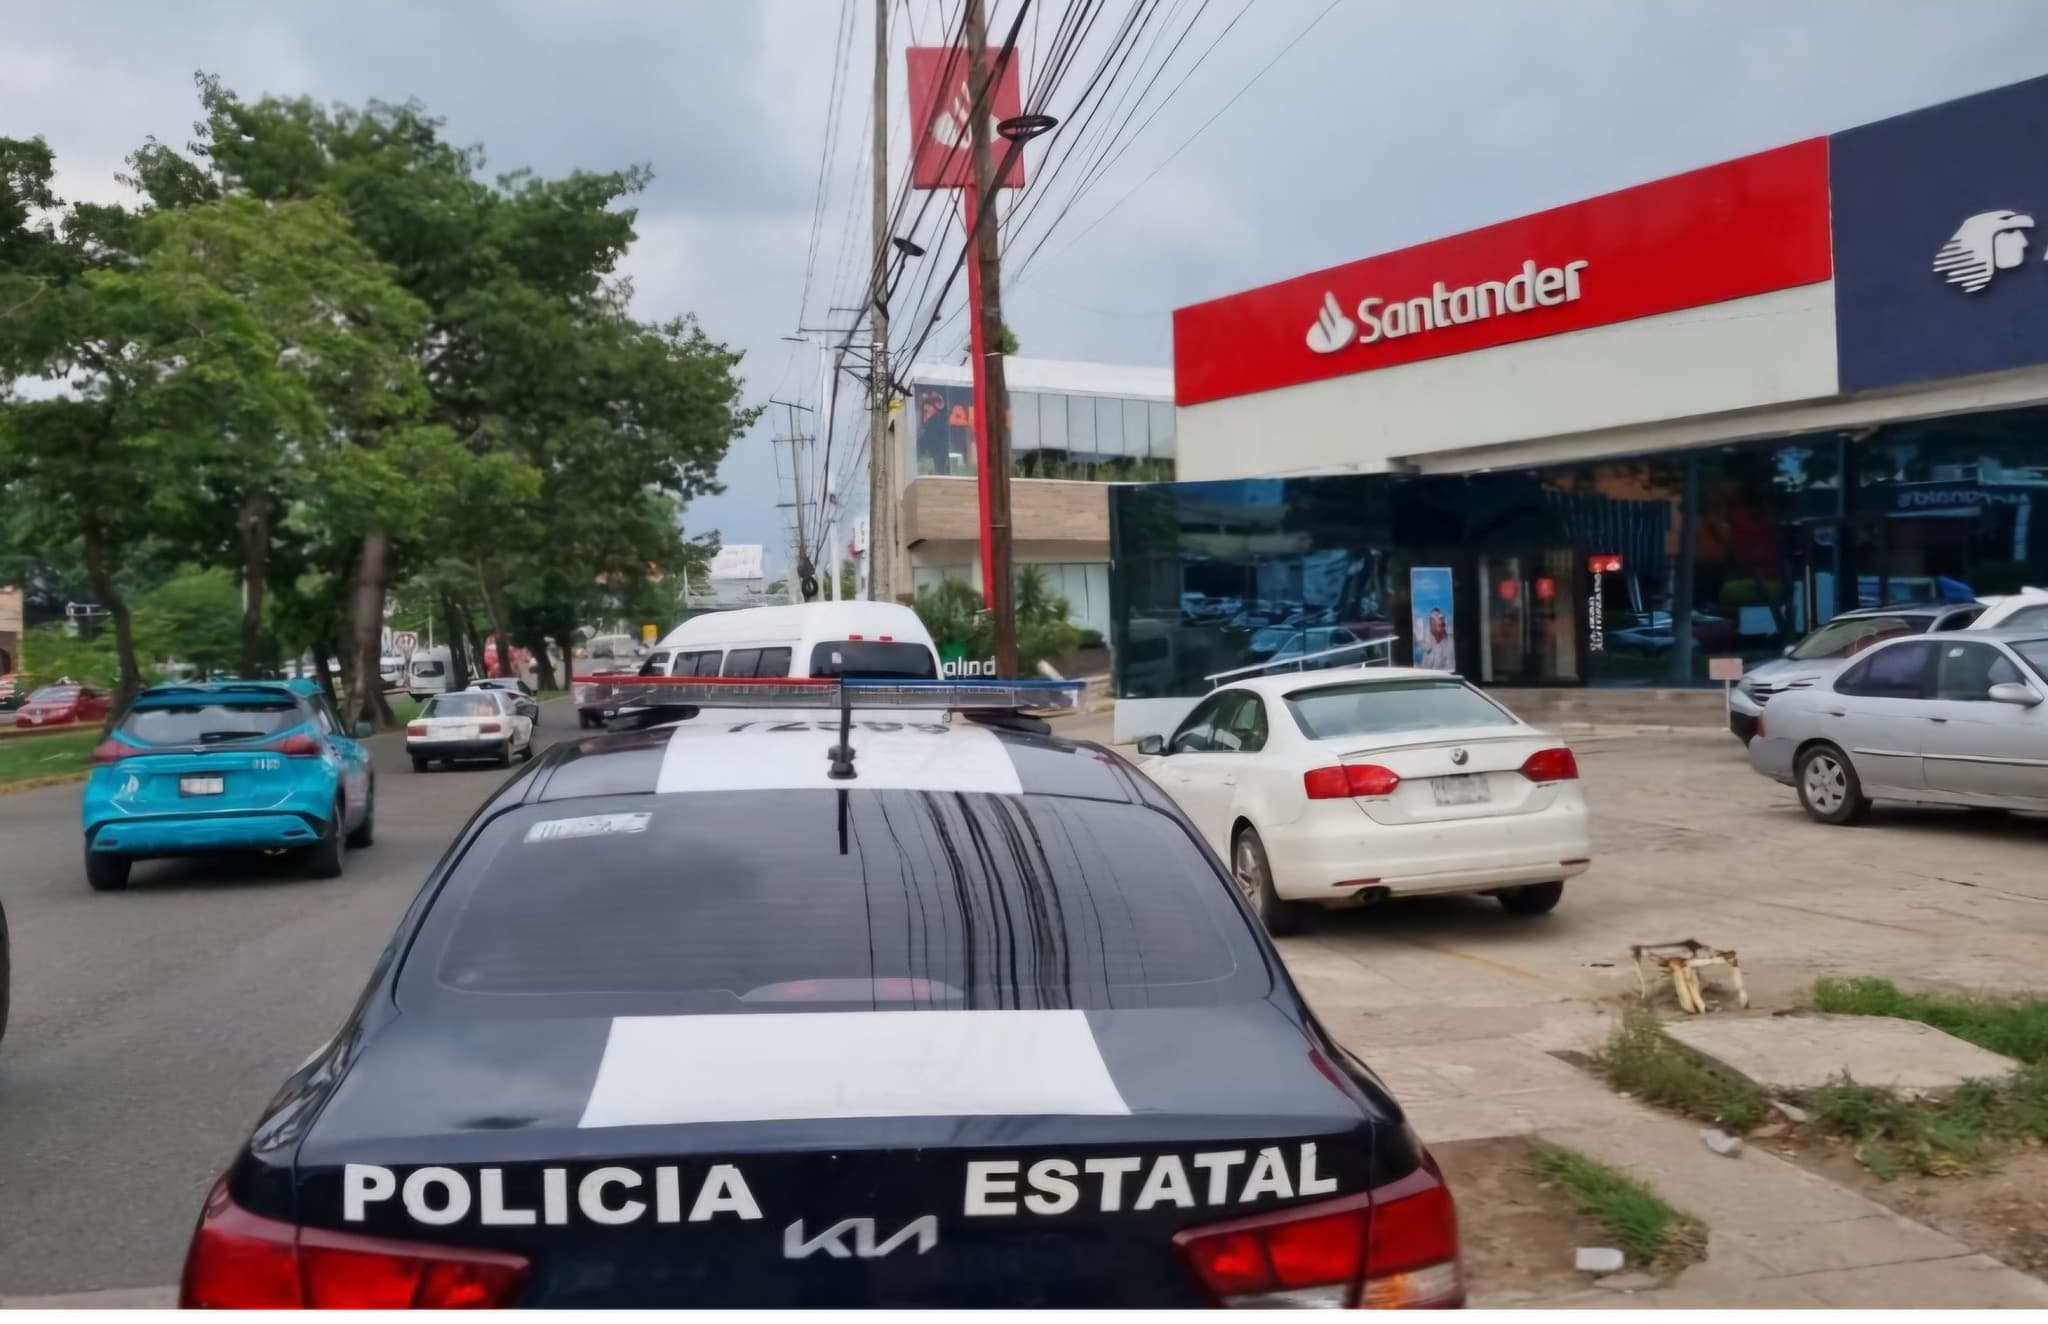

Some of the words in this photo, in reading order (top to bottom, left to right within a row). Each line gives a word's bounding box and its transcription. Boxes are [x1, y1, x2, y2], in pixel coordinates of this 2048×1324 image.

[1357, 258, 1588, 344] Santander
[343, 1163, 764, 1226] POLICIA
[963, 1141, 1338, 1217] ESTATAL
